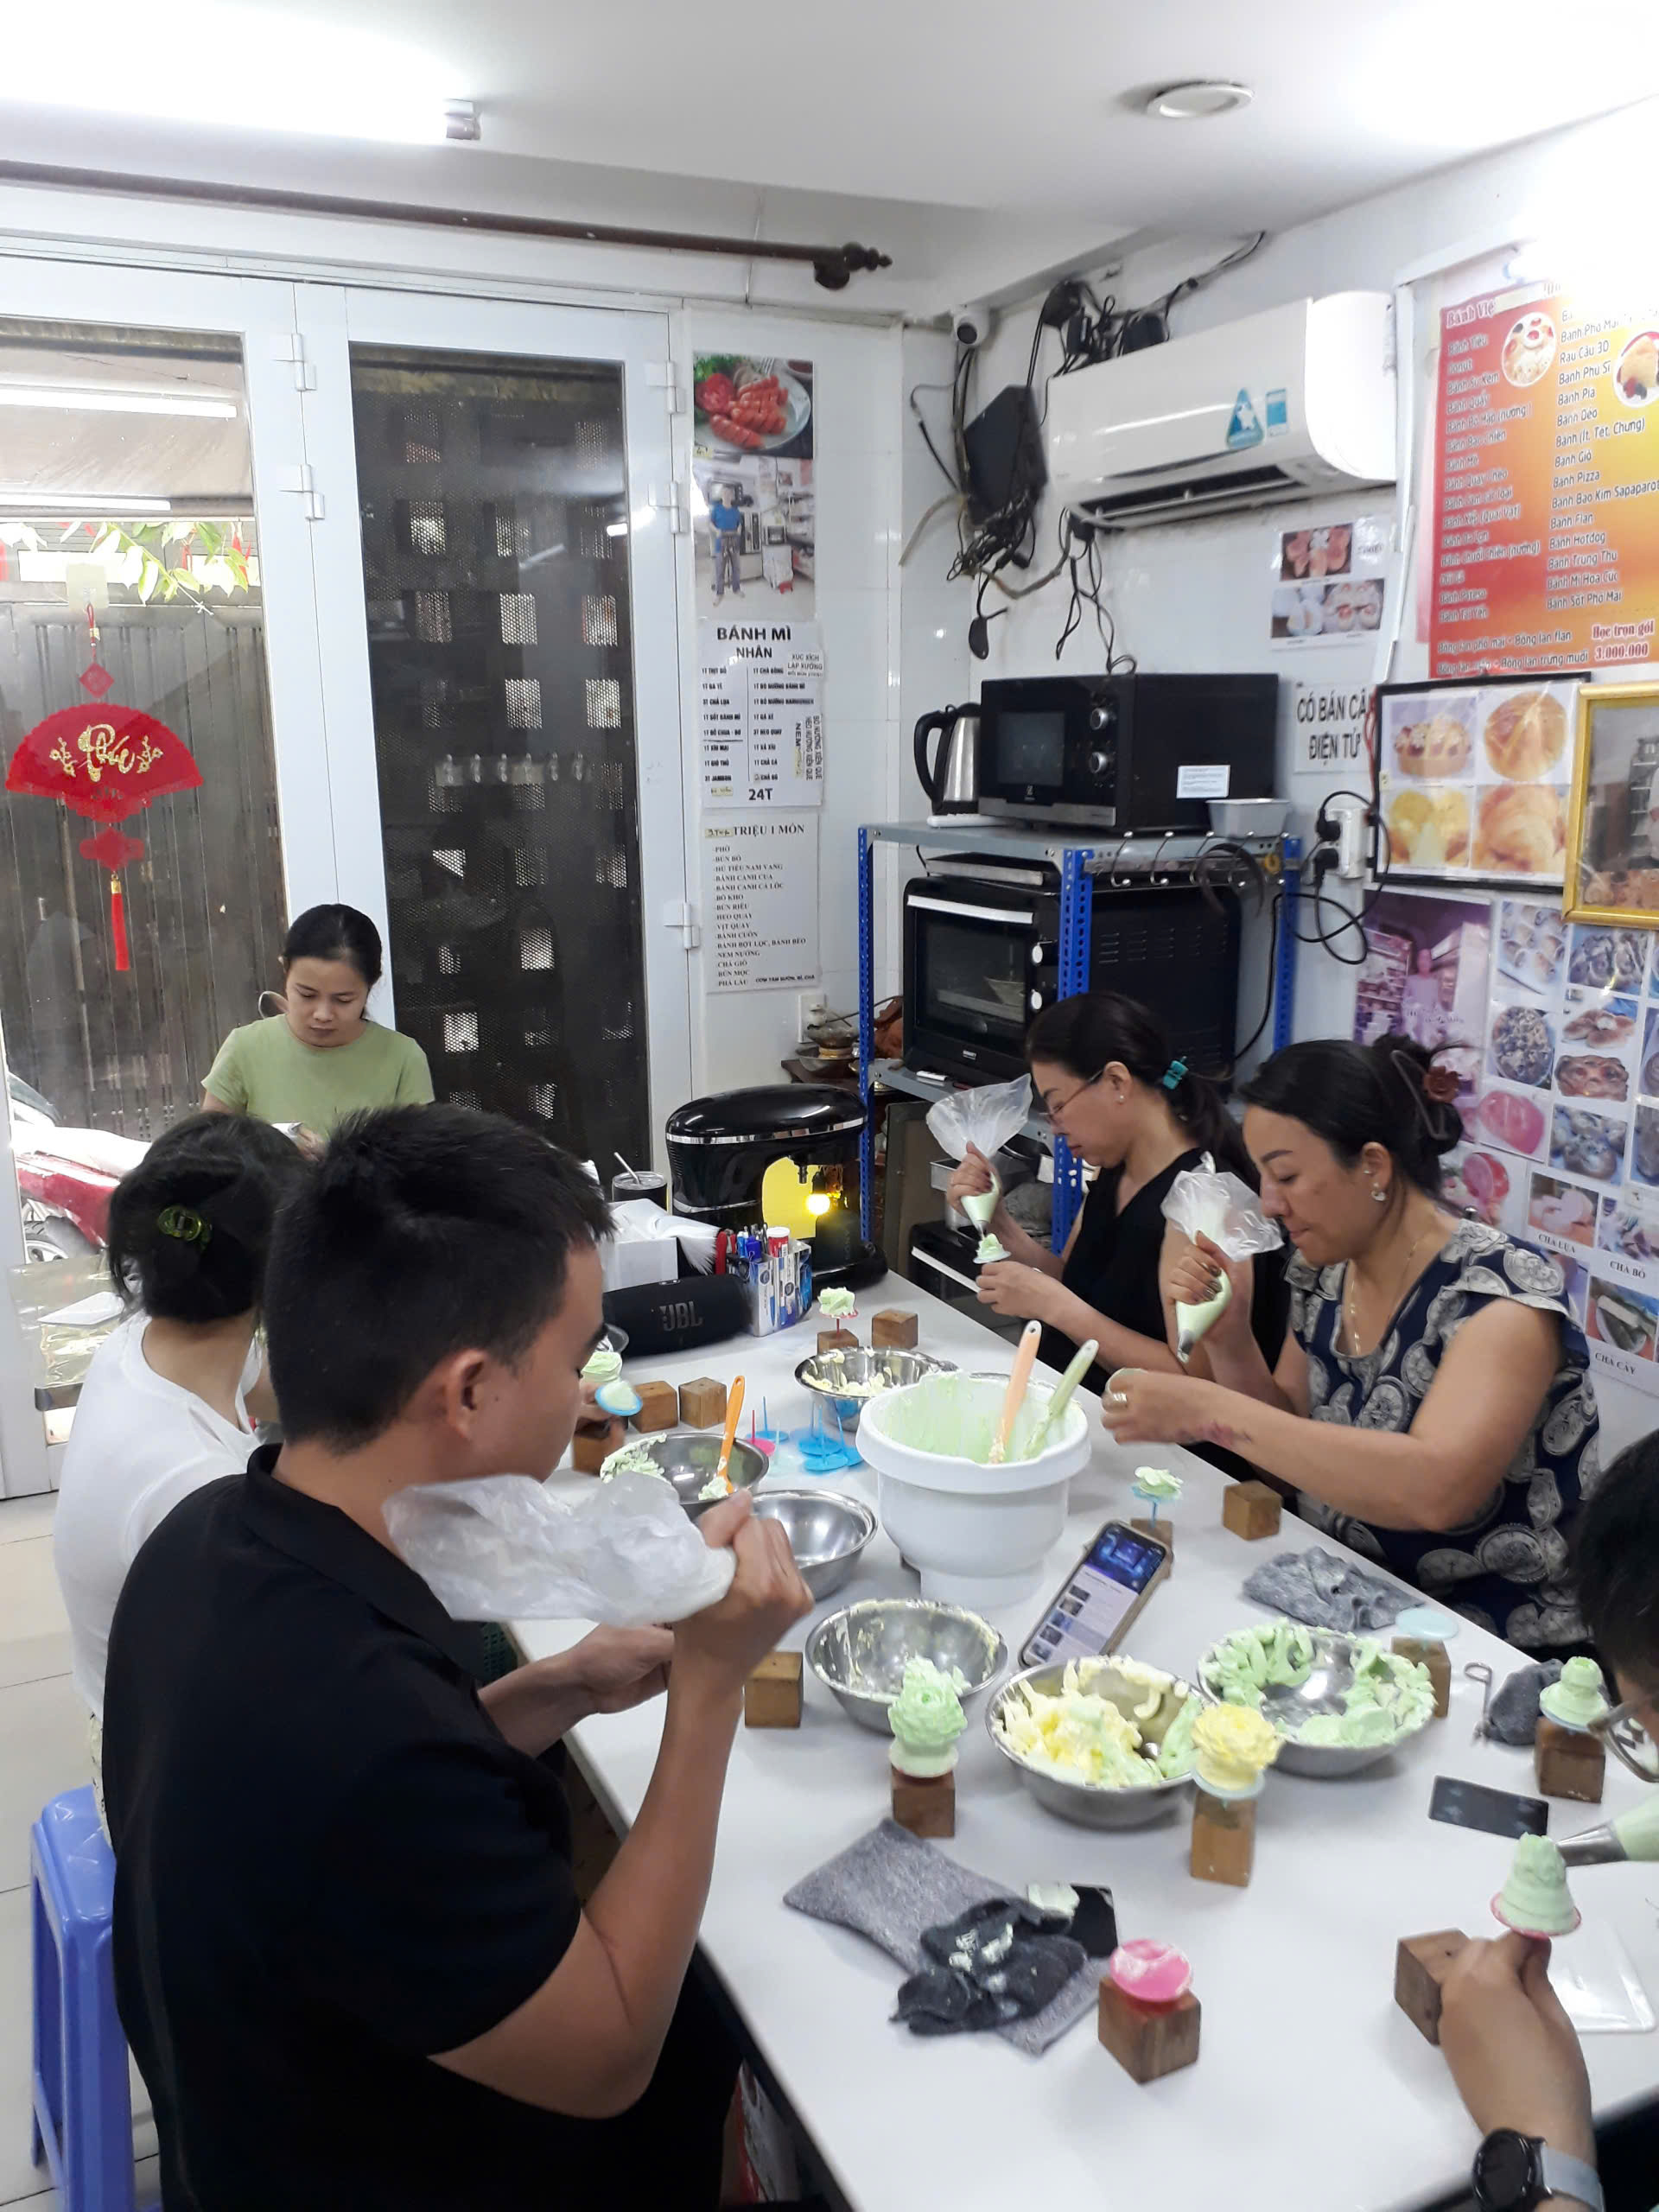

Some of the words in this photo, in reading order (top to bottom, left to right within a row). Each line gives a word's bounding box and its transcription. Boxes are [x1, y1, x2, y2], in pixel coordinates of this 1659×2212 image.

[1598, 340, 1609, 353] 3D
[1577, 470, 1600, 484] Pizza
[1595, 489, 1611, 501] Kim
[1574, 532, 1605, 545] Hotdog
[1573, 553, 1598, 566] Trung
[1601, 550, 1617, 561] Thu
[717, 625, 766, 641] BÁNH
[772, 625, 791, 641] MÌ
[1297, 690, 1315, 723] CÓ
[1319, 690, 1346, 721] BÁN
[1309, 731, 1338, 766] ĐIỆN
[748, 787, 773, 801] 24T
[733, 824, 767, 837] TRIỆU
[659, 1300, 703, 1332] JBL
